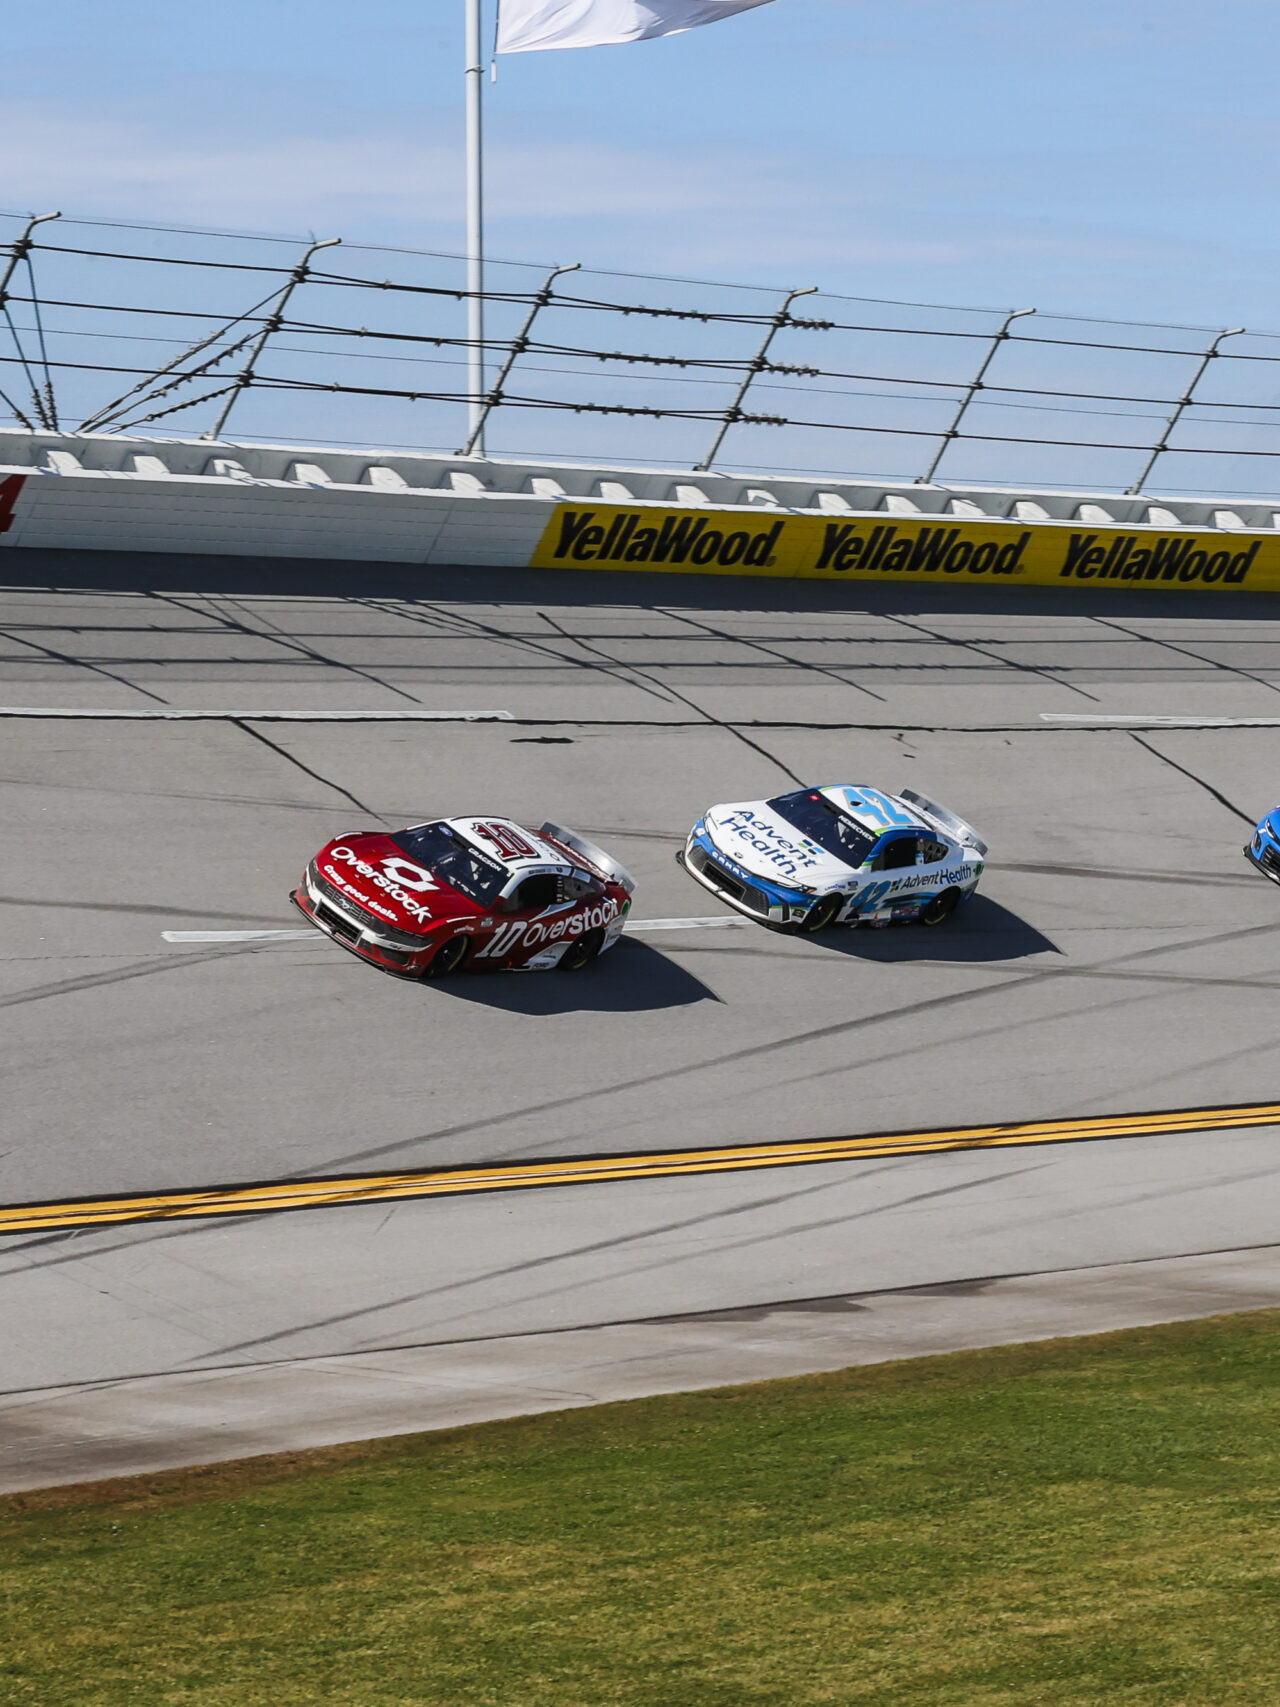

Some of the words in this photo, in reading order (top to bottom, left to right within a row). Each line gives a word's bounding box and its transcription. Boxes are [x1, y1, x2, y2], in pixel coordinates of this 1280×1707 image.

[553, 511, 786, 567] YellaWood
[816, 523, 1032, 575] YellaWood
[1060, 533, 1262, 584] YellaWood
[838, 814, 877, 842] NEMECHEK
[842, 786, 914, 827] 42
[467, 847, 502, 872] GRAGSON
[471, 821, 542, 864] 10
[719, 817, 797, 875] Health
[732, 809, 817, 868] Advent
[323, 864, 347, 885] Crazy
[342, 884, 370, 903] good
[367, 900, 399, 922] deals.
[330, 846, 433, 924] Overstock
[850, 879, 893, 914] 42
[473, 920, 528, 958] 10
[522, 897, 619, 948] Overstock
